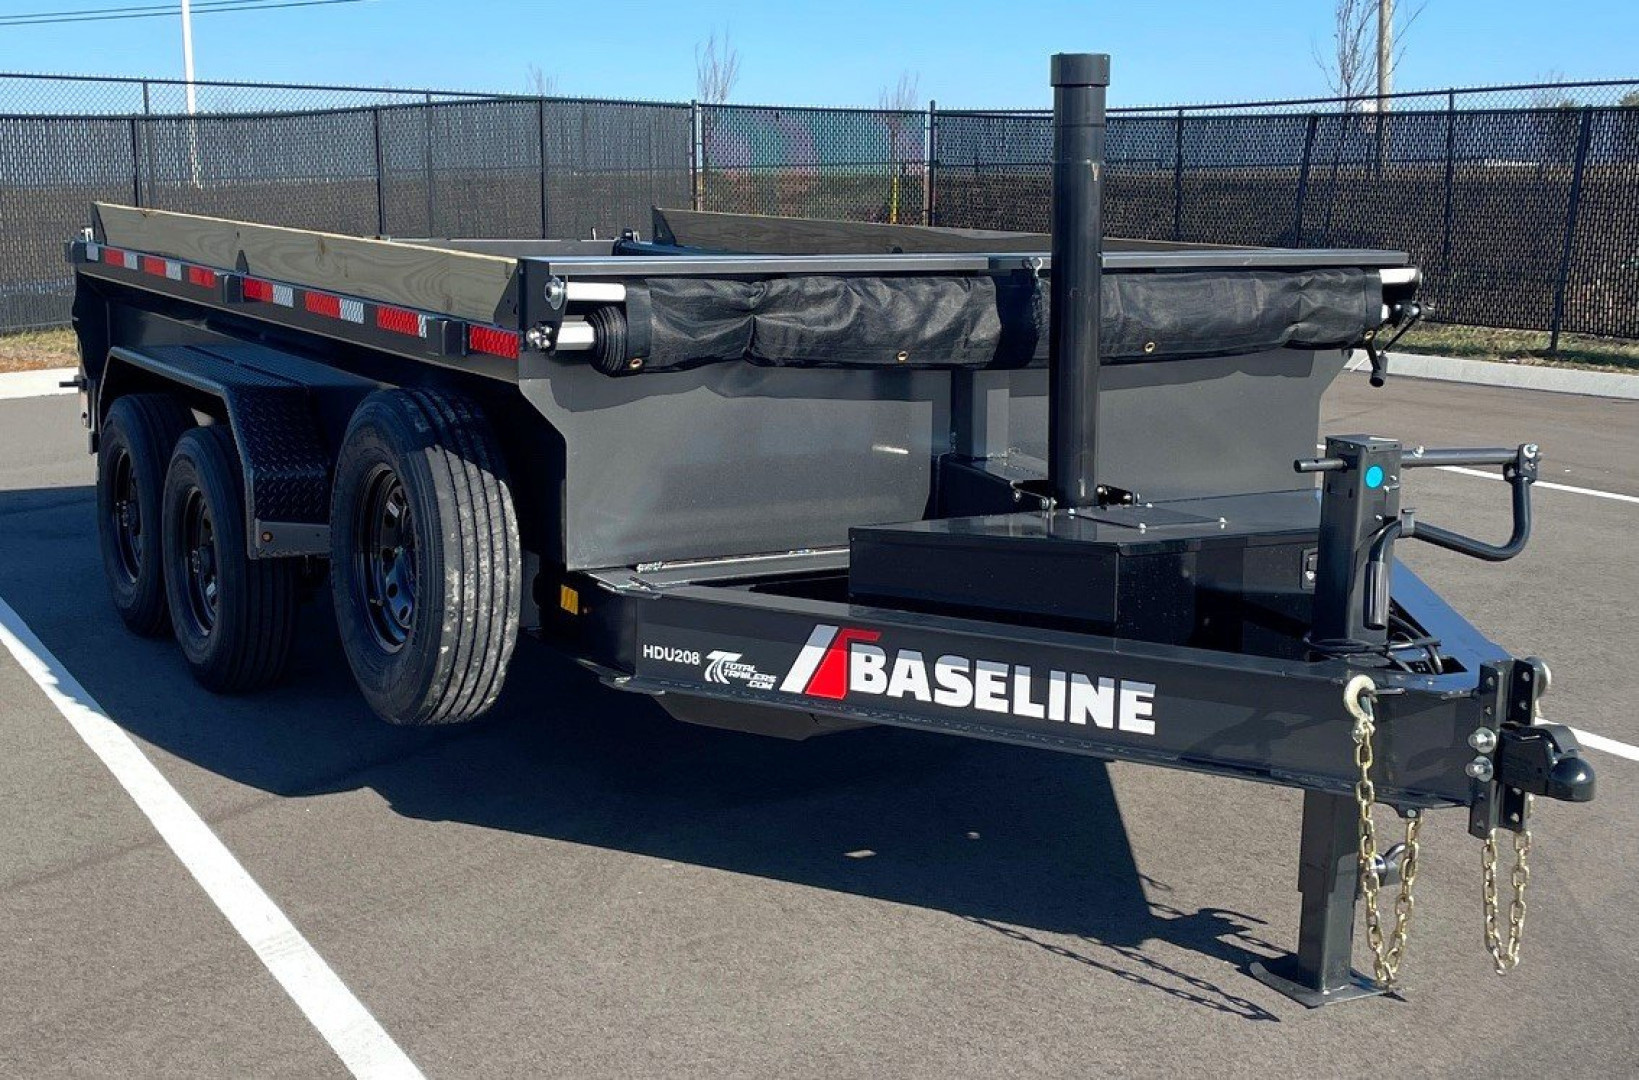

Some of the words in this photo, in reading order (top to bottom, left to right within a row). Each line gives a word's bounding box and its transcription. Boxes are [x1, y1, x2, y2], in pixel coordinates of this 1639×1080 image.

[643, 644, 700, 666] HDU208
[725, 662, 757, 673] TOTAL
[723, 670, 776, 683] TRAILERS
[851, 642, 1156, 735] BASELINE
